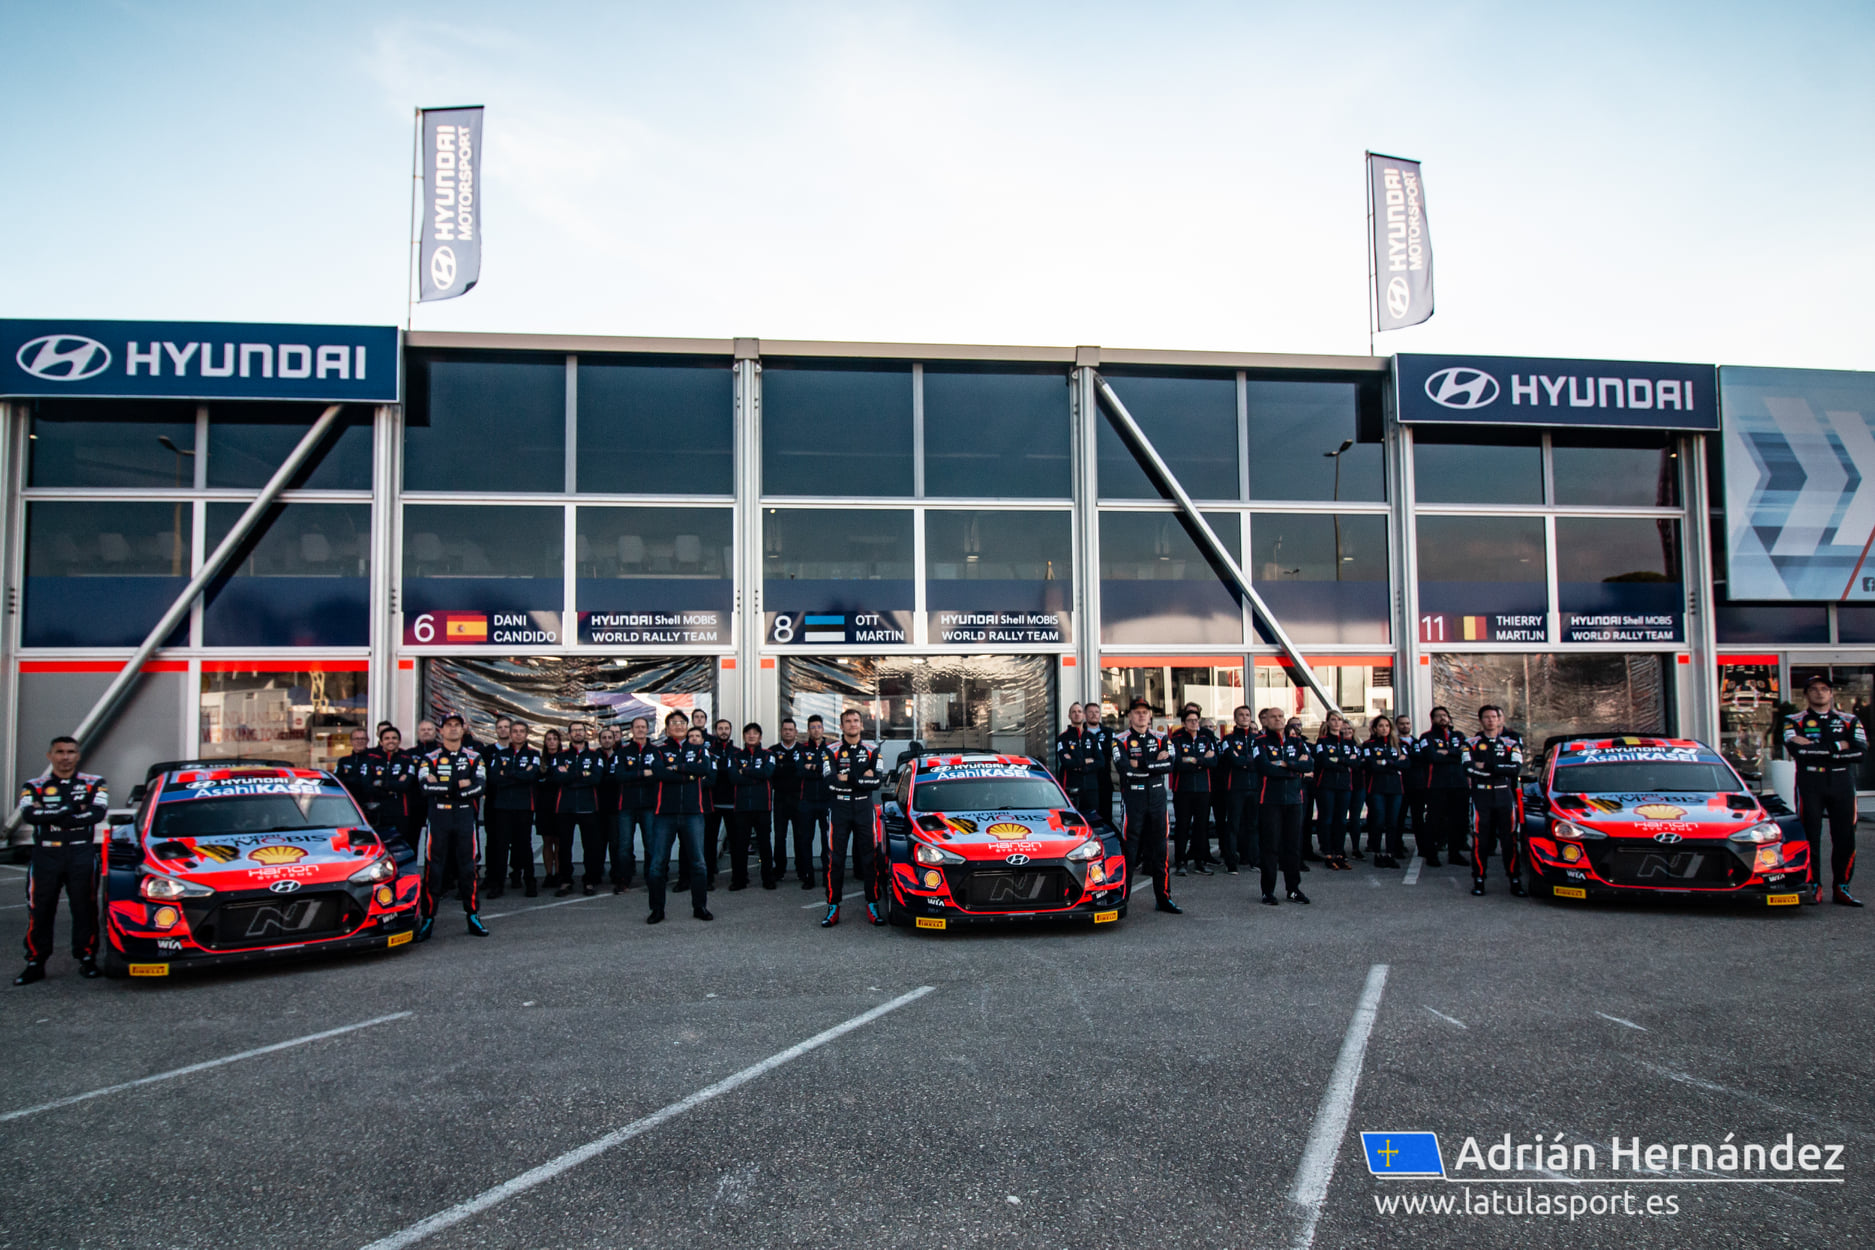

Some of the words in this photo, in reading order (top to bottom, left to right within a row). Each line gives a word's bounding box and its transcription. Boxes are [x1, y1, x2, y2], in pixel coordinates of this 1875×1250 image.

[435, 125, 456, 241] HYUNDAI
[457, 126, 473, 241] MOTORSPORT
[1384, 168, 1407, 272] HYUNDAI
[1402, 170, 1423, 271] MOTORSPORT
[126, 341, 366, 380] HYUNDAI
[1511, 374, 1694, 411] HYUNDAI
[494, 615, 527, 626] DANI
[591, 615, 653, 626] HYUNDAI
[655, 614, 681, 626] Shell
[682, 615, 717, 626] MOBIS
[856, 615, 879, 626] OTT
[940, 615, 998, 625] HYUNDAI
[1000, 615, 1025, 625] Shell
[1027, 615, 1059, 625] MOBIS
[1496, 616, 1542, 626] THIERRY
[1571, 616, 1622, 626] HYUNDAI
[1622, 615, 1643, 625] Shell
[1645, 616, 1673, 625] MOBIS
[414, 614, 435, 642] 6
[774, 615, 794, 642] 8
[1421, 615, 1444, 641] 11
[493, 631, 557, 642] CANDIDO
[592, 631, 640, 642] WORLD
[642, 631, 680, 642] RALLY
[682, 631, 718, 642] TEAM
[855, 630, 905, 642] MARTIN
[941, 631, 986, 641] WORLD
[988, 630, 1024, 641] RALLY
[1026, 630, 1059, 641] TEAM
[1496, 630, 1545, 641] MARTIJN
[1571, 630, 1611, 640] WORLD
[1612, 630, 1644, 640] RALLY
[1645, 630, 1673, 640] TEAM
[220, 777, 289, 786] HYUNDAI
[976, 814, 1047, 822] MOBIS
[233, 835, 327, 847] MOBIS
